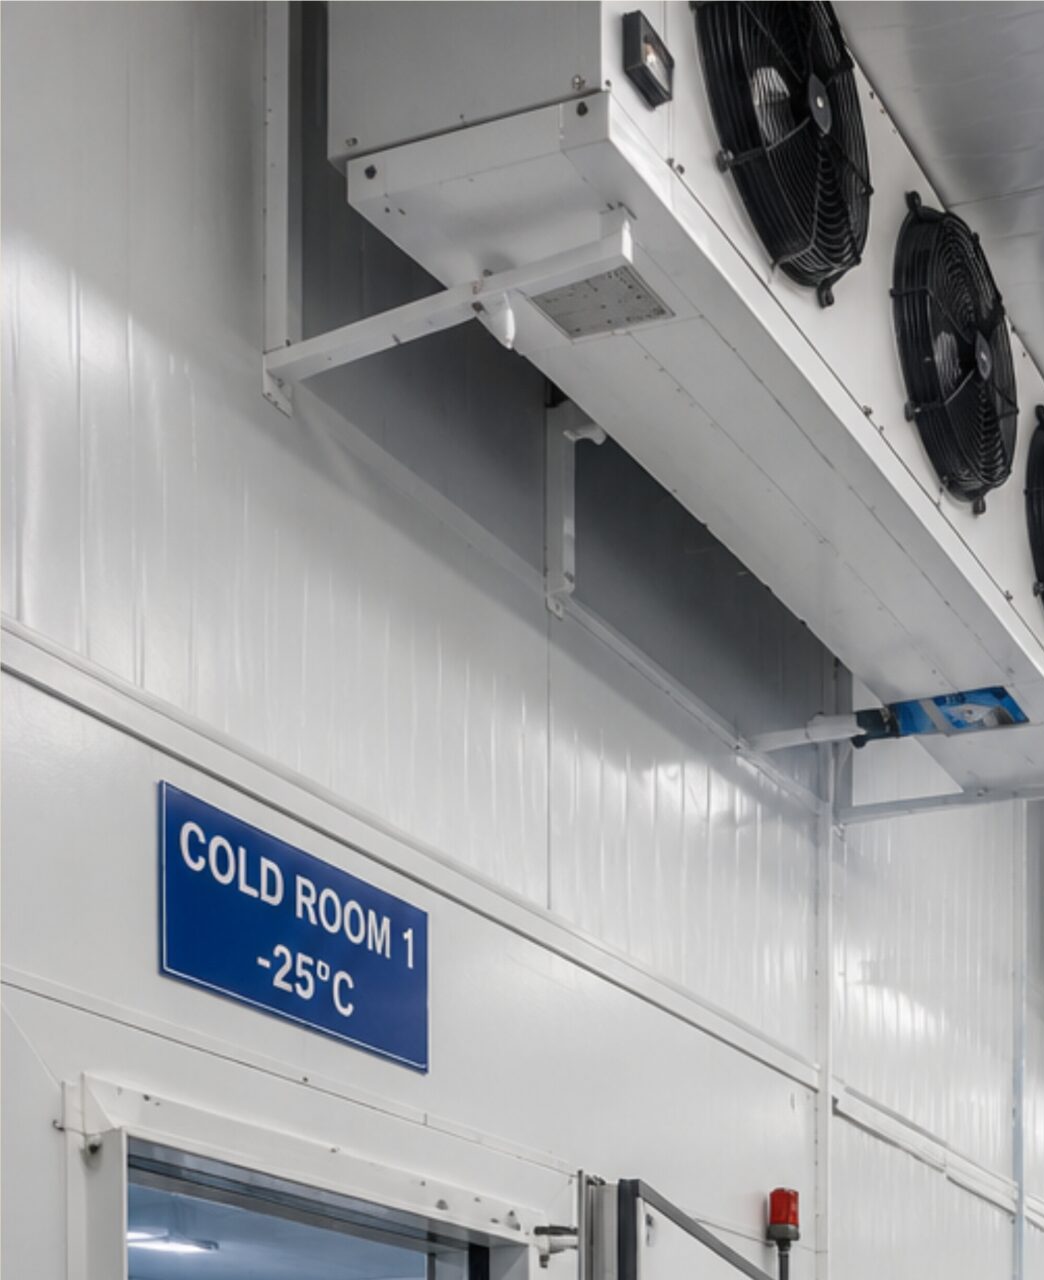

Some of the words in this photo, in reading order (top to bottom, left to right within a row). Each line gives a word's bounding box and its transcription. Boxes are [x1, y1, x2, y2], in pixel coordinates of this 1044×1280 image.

[180, 821, 284, 906] COLD
[295, 874, 391, 959] ROOM
[403, 928, 414, 969] 1
[257, 944, 354, 1017] -25°C
